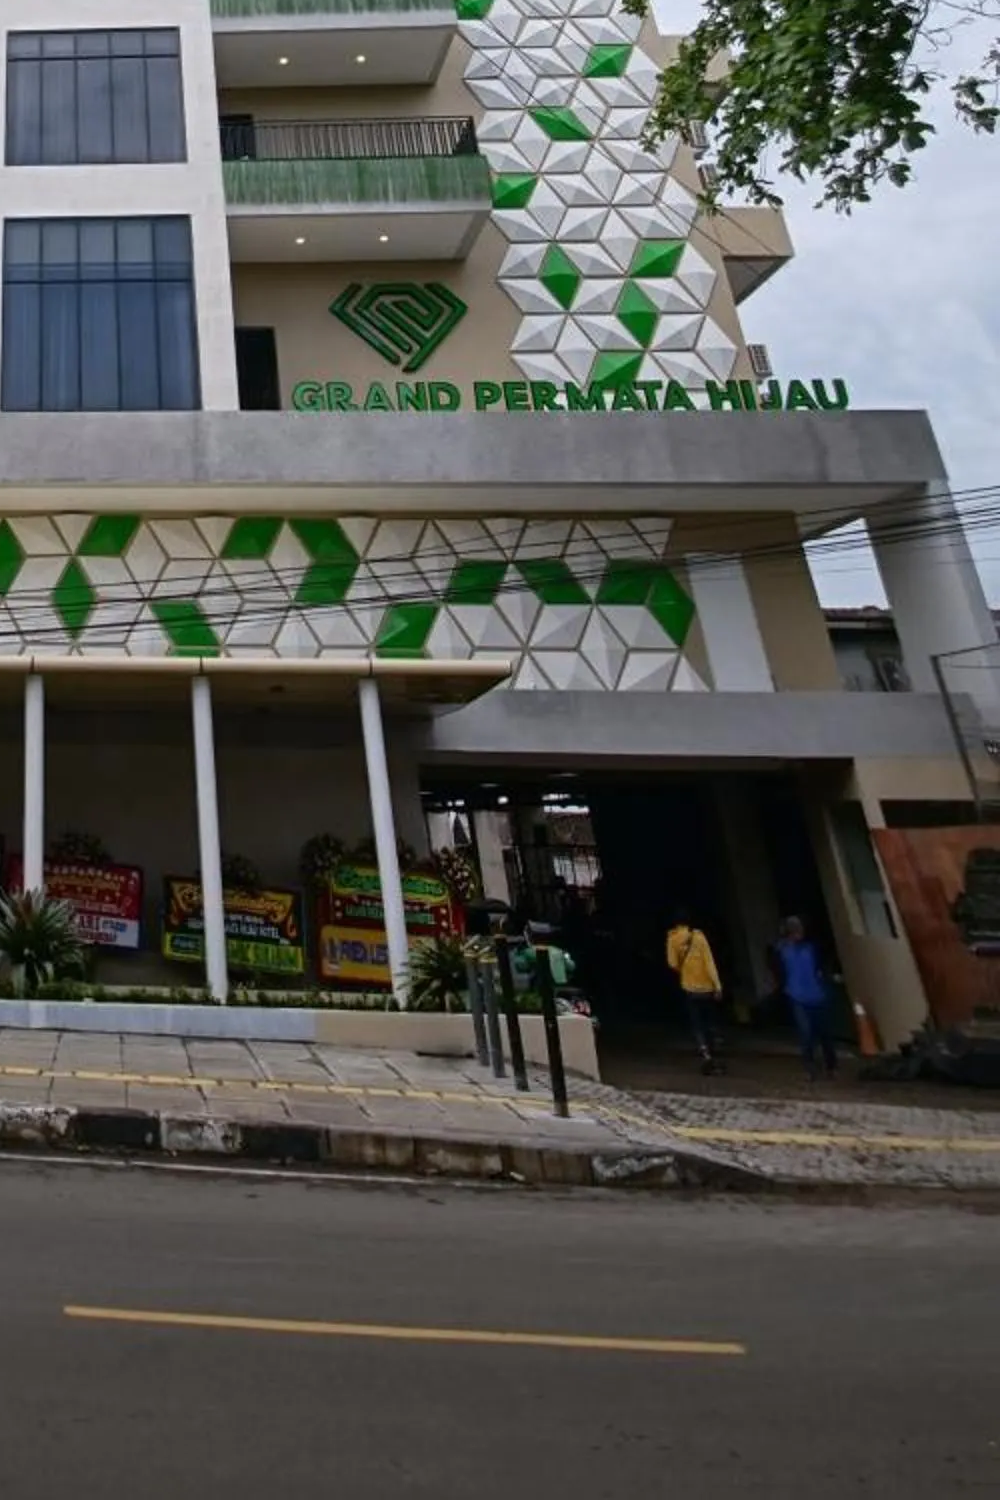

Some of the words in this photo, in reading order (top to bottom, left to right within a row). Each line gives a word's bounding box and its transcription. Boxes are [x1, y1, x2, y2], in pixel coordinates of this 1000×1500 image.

[292, 380, 461, 412] GRAND
[473, 380, 697, 412] PERMATA
[706, 379, 851, 412] HIJAU
